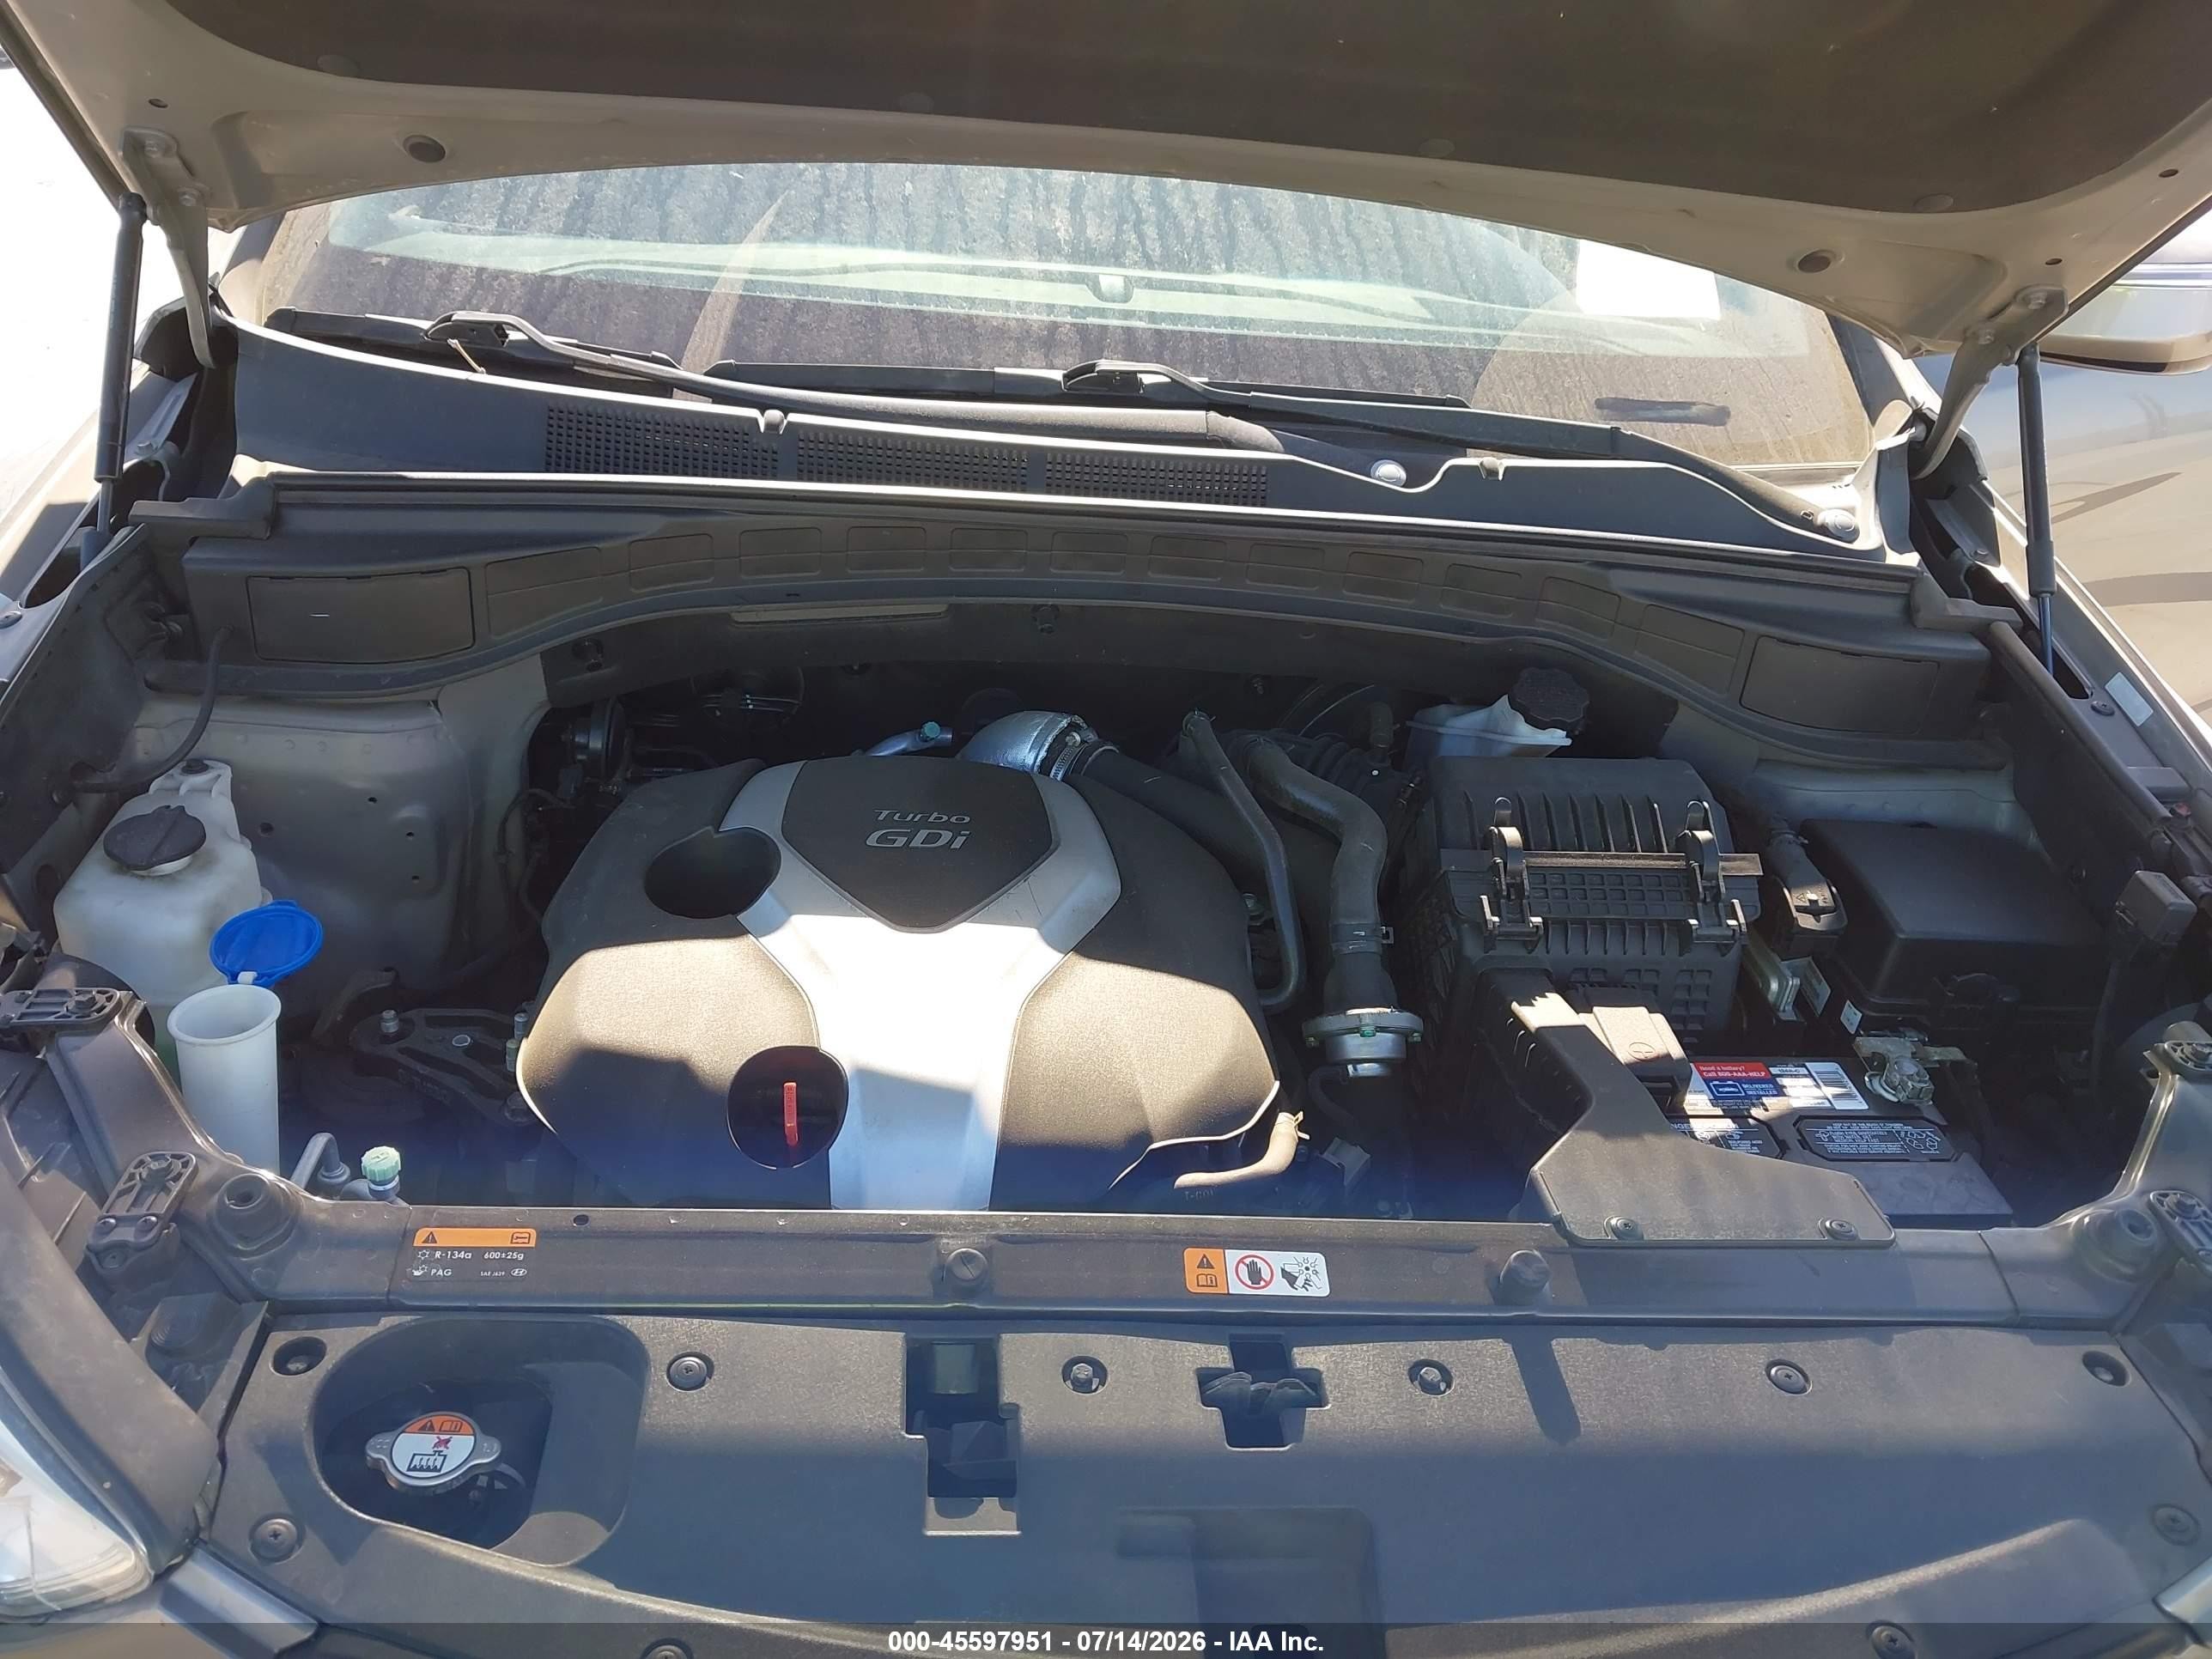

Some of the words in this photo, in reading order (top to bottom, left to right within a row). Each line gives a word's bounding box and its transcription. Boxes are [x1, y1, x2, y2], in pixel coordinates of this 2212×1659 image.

[874, 809, 971, 823] Turbo
[866, 829, 971, 849] GDi
[434, 1250, 472, 1259] R-134a
[483, 1251, 524, 1260] 600±25g
[430, 1268, 453, 1277] PAG
